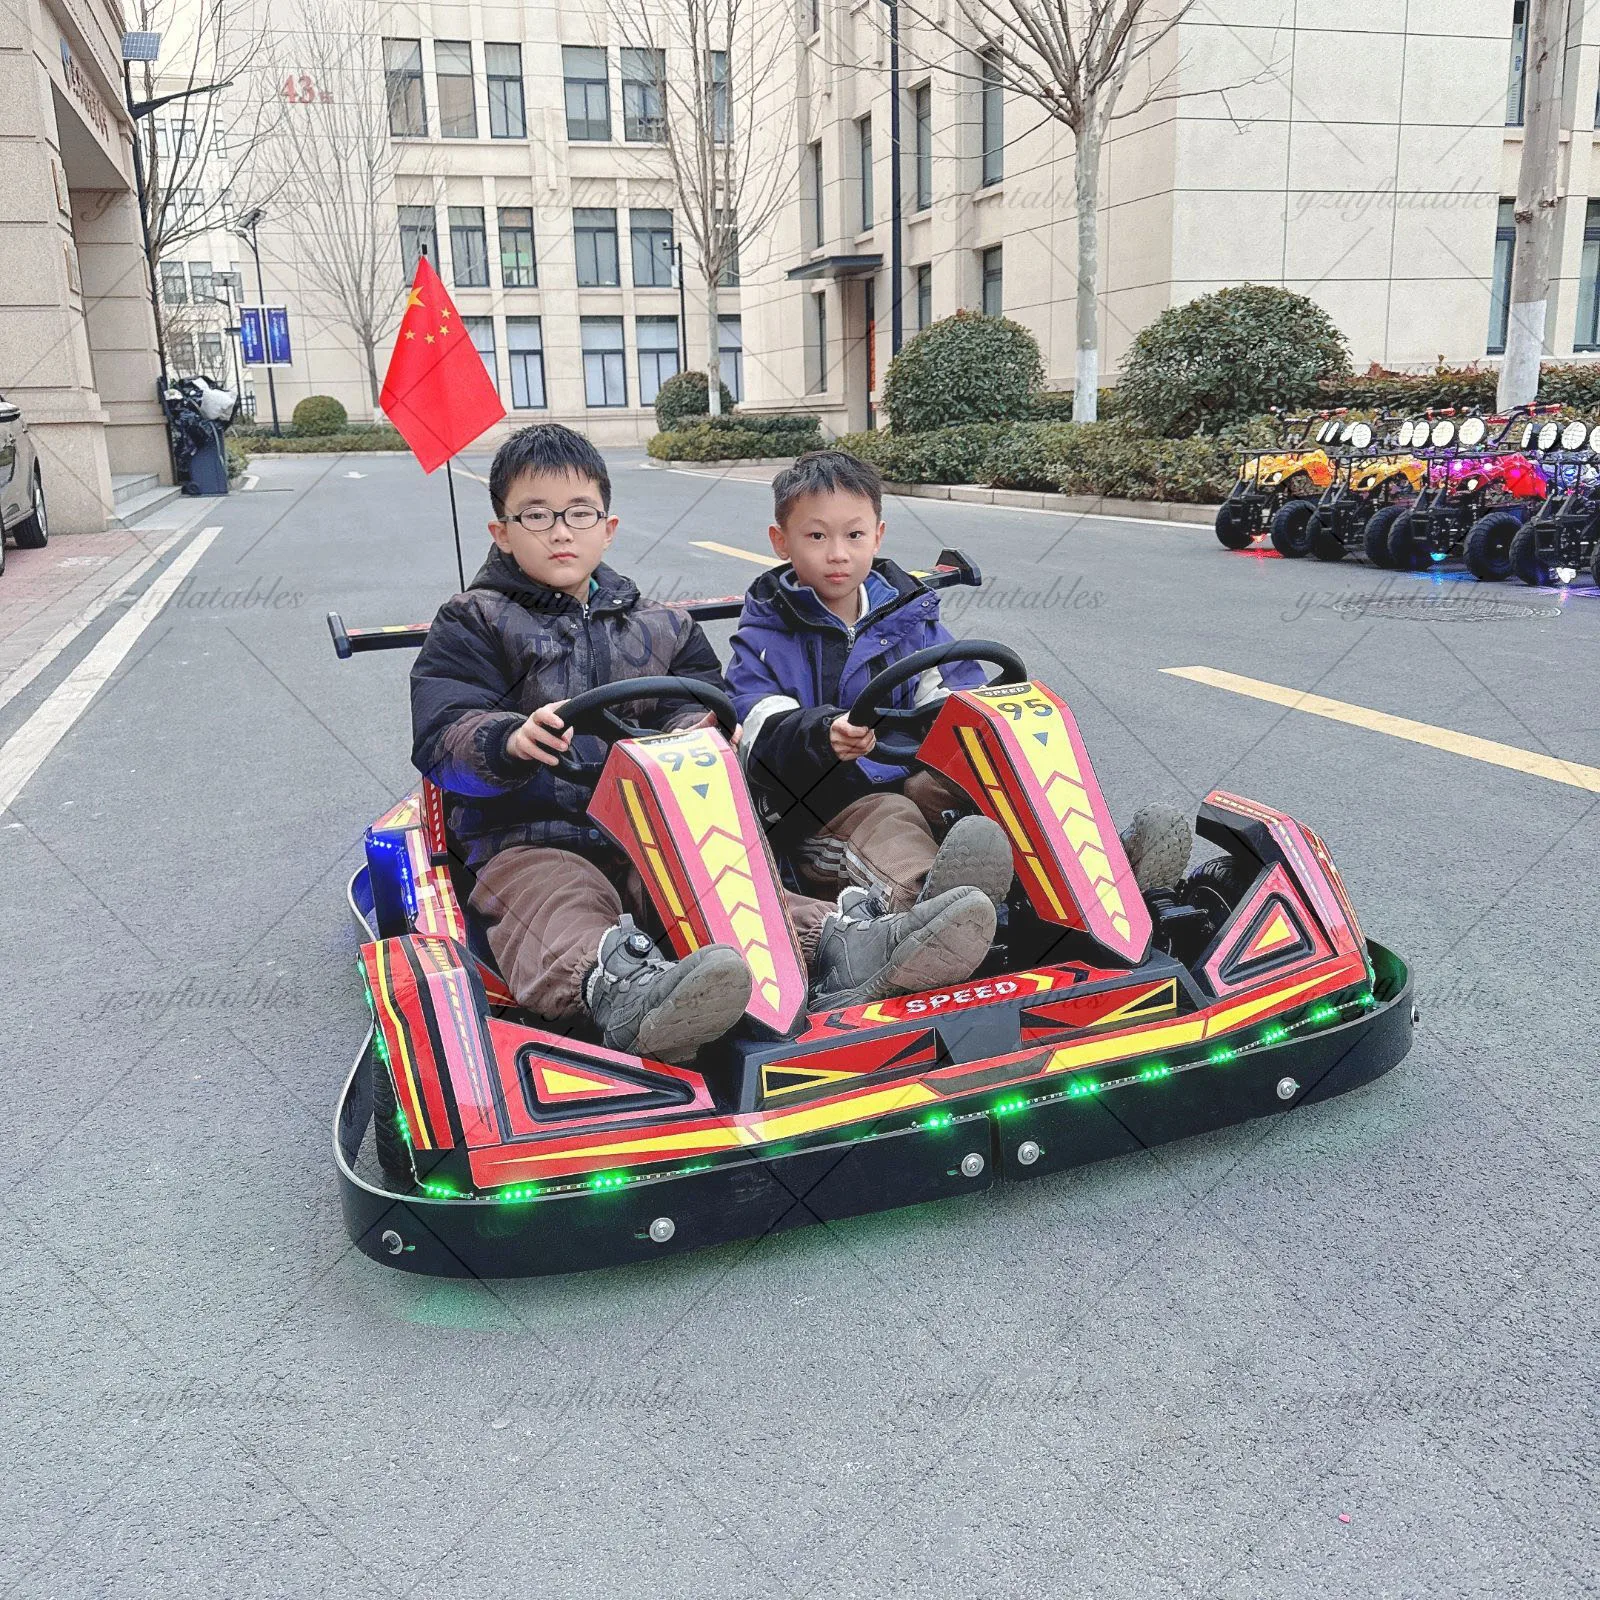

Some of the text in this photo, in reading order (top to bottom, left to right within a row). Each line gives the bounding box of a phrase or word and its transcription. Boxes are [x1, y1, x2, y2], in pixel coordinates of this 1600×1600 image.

[984, 686, 1025, 697] SPEED
[997, 698, 1053, 720] 95
[657, 746, 717, 772] 95
[905, 980, 1018, 1013] SPEED
